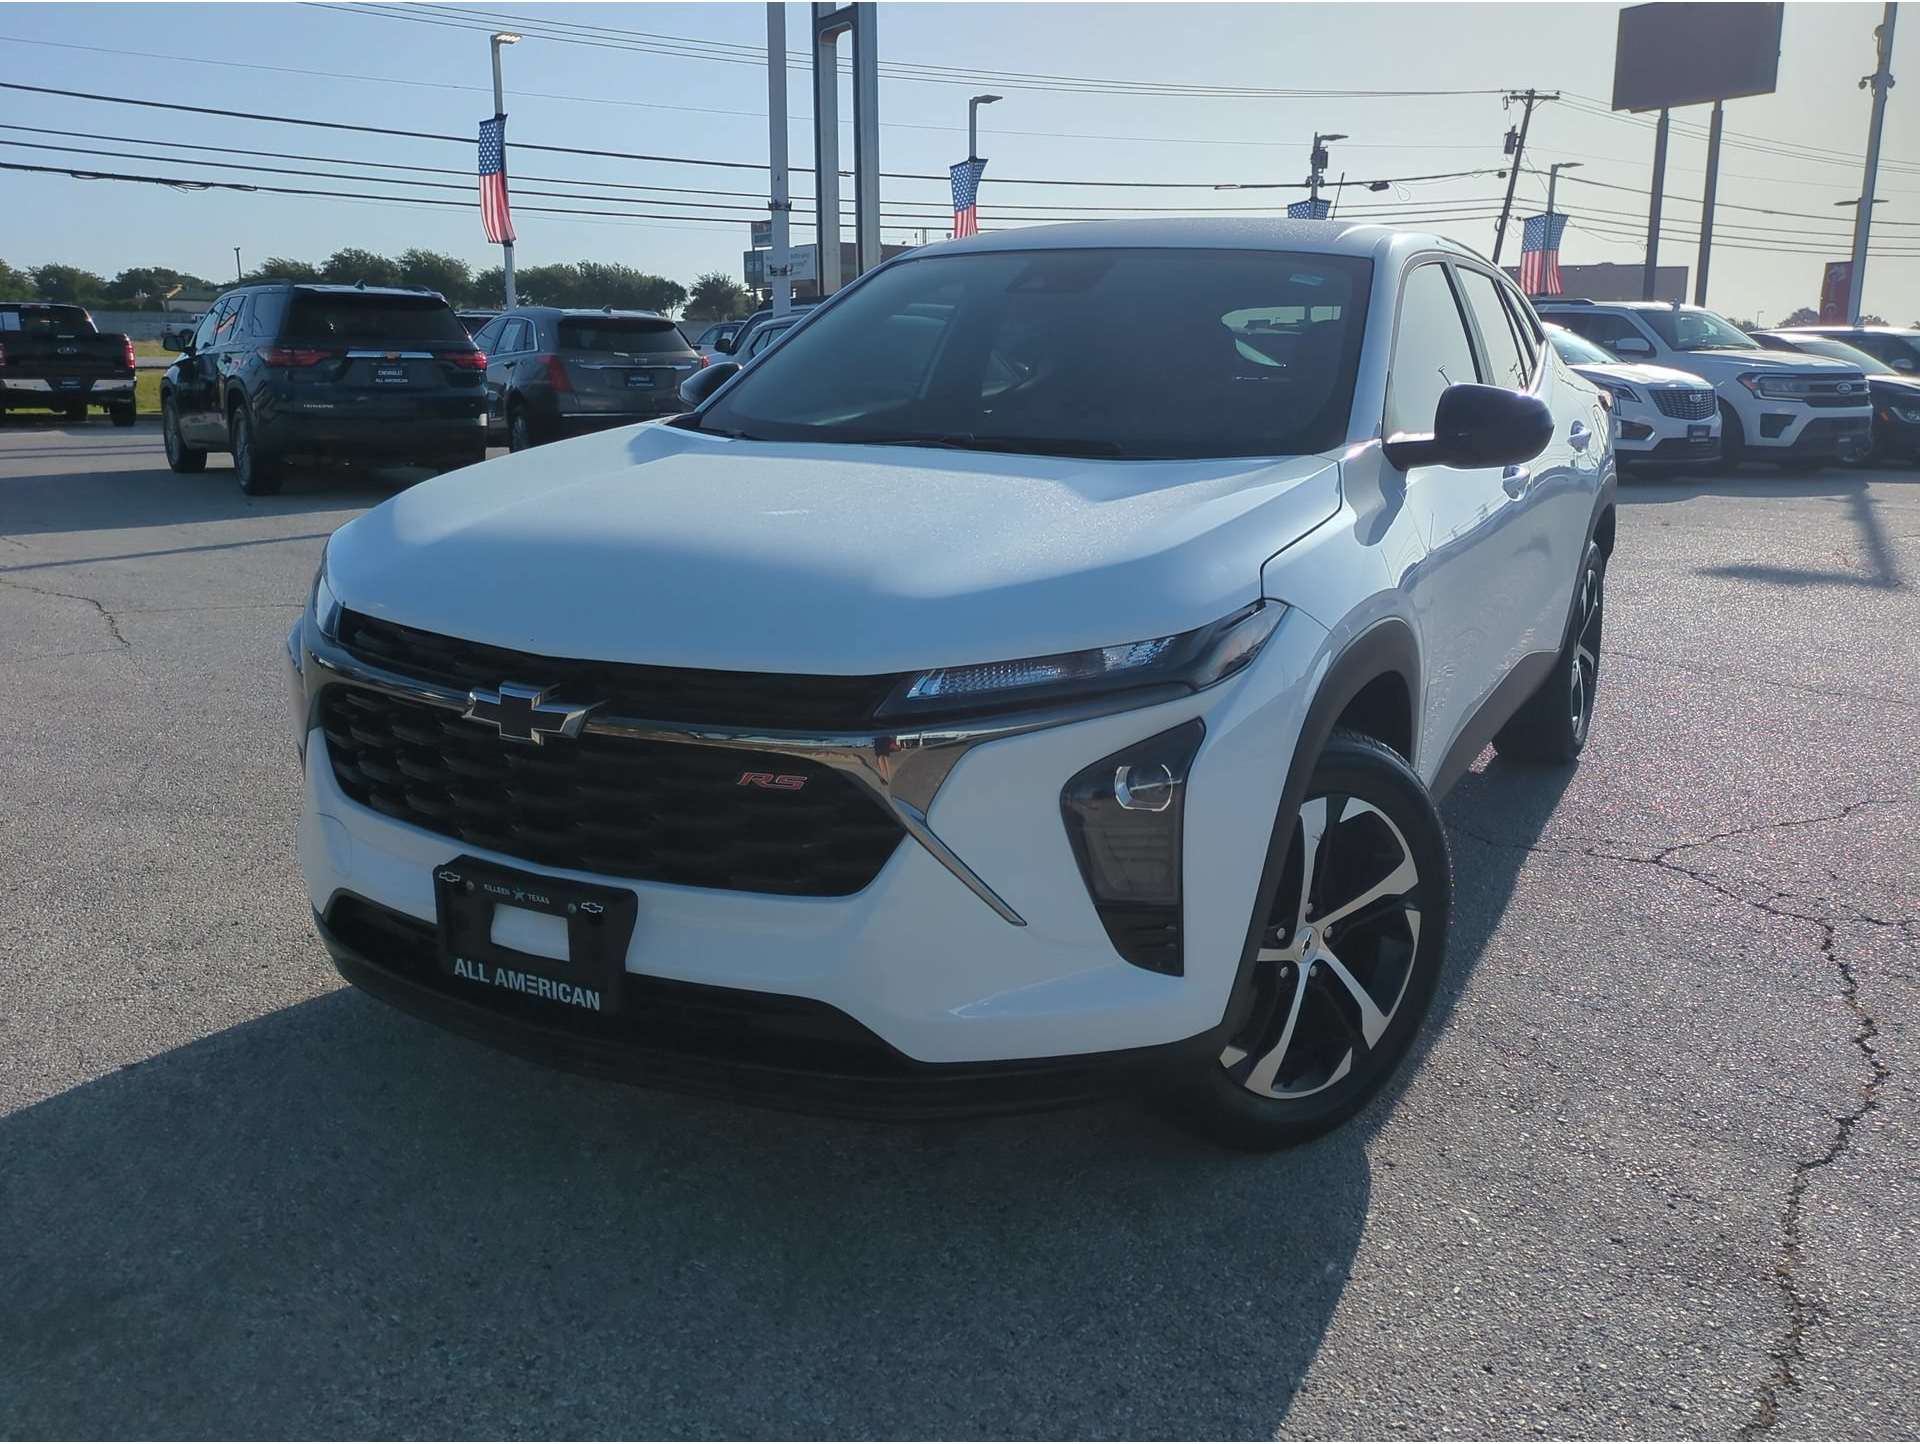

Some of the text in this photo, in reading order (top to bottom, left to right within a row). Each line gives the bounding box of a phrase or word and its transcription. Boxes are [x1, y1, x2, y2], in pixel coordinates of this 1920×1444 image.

[737, 772, 808, 790] RS
[527, 893, 550, 905] TEXAS
[453, 958, 601, 1011] ALL AMERICAN
